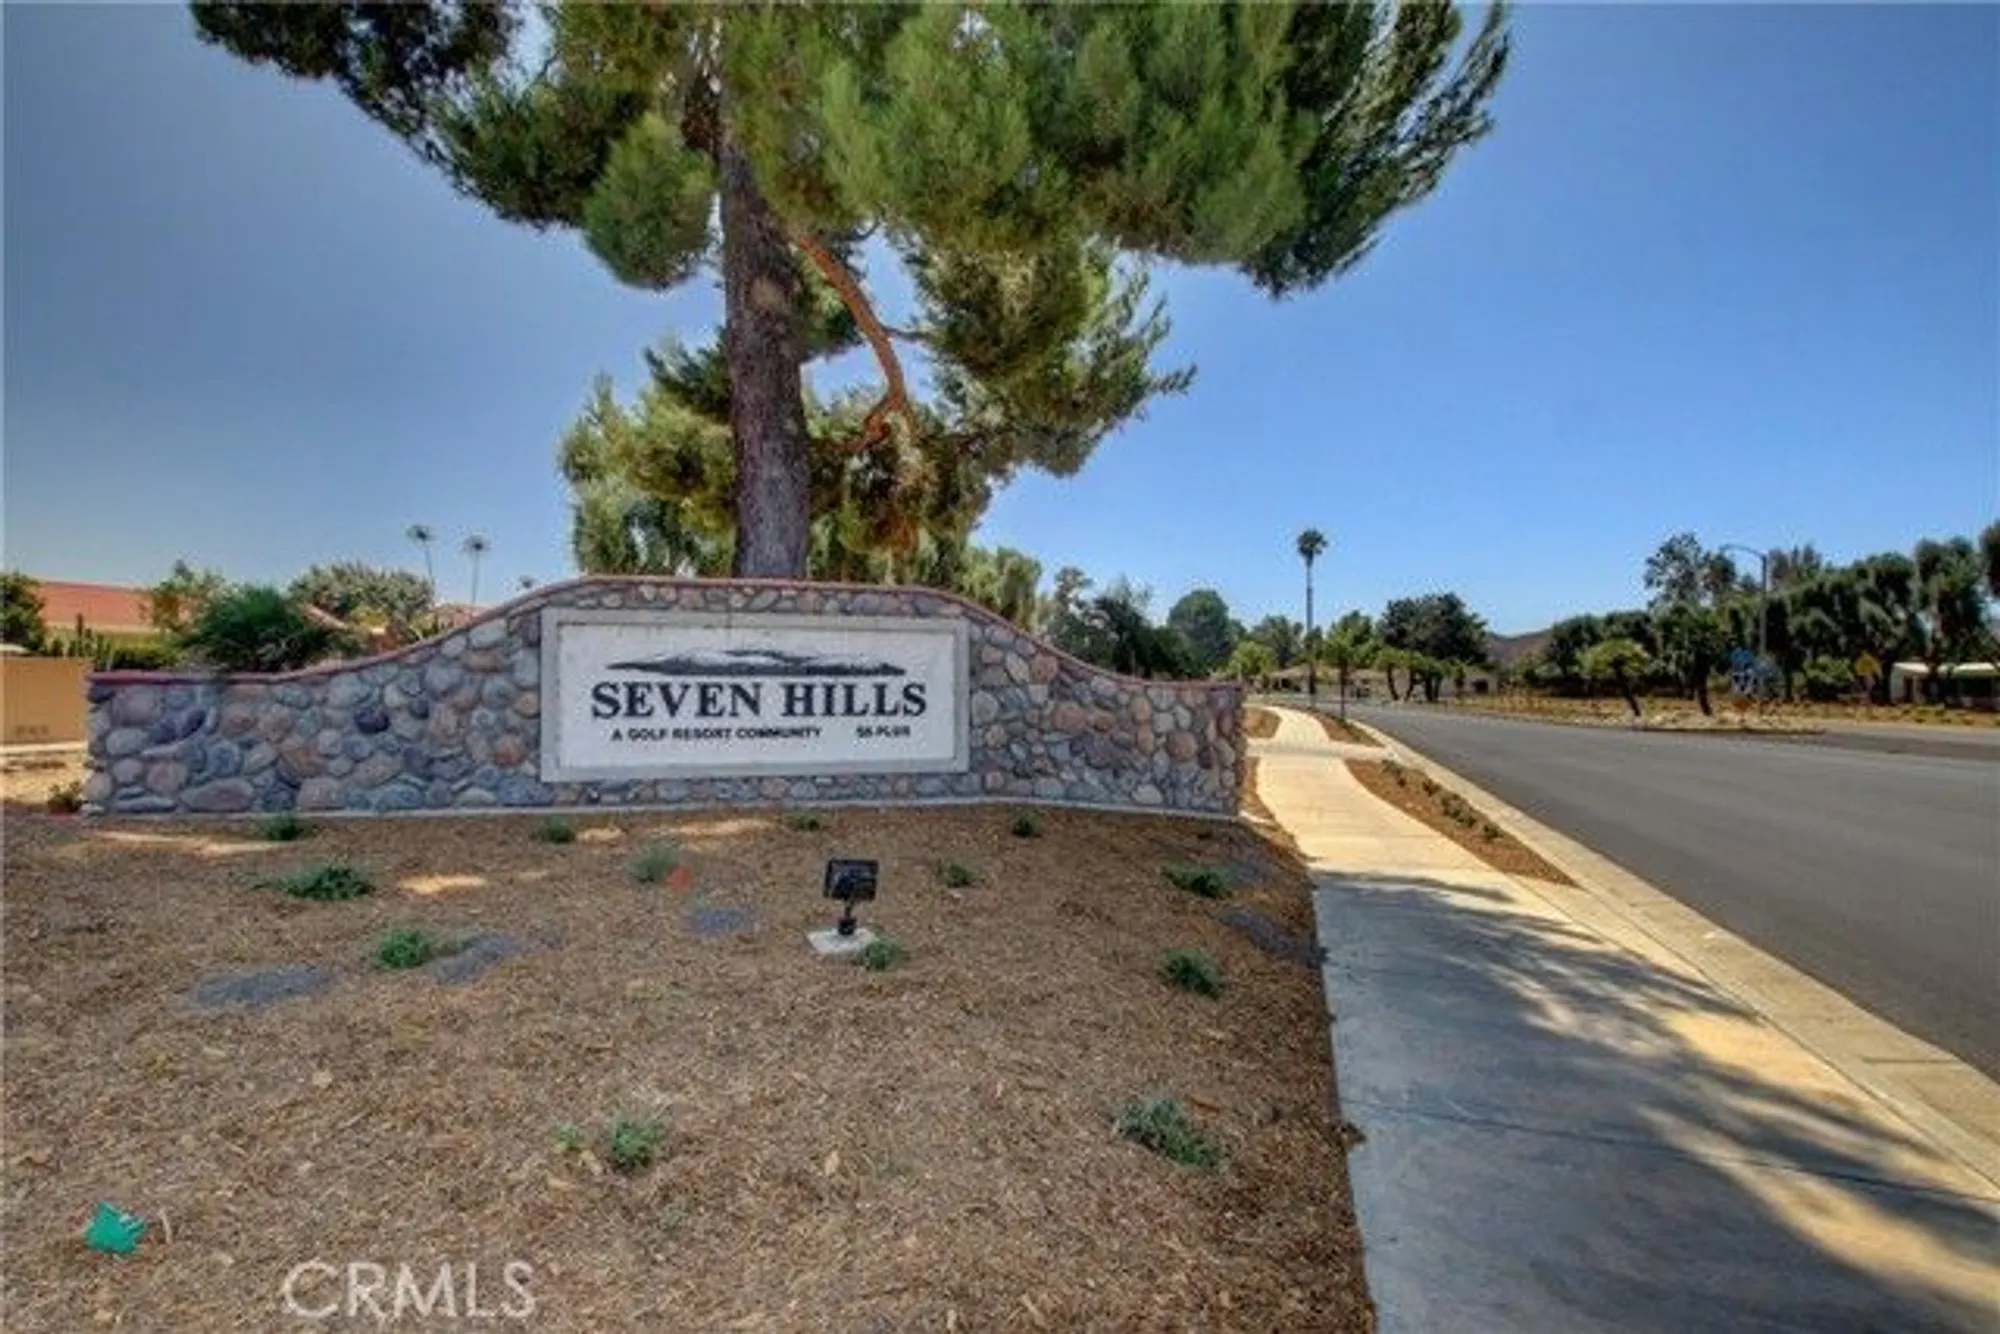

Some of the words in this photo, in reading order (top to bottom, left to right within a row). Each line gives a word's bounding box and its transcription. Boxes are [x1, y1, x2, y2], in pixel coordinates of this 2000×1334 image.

[590, 681, 762, 719] SEVEN
[781, 681, 928, 718] HILLS
[610, 727, 624, 742] A
[627, 727, 667, 741] GOLF
[671, 726, 733, 740] RESORT
[735, 725, 823, 740] COMMUNITY
